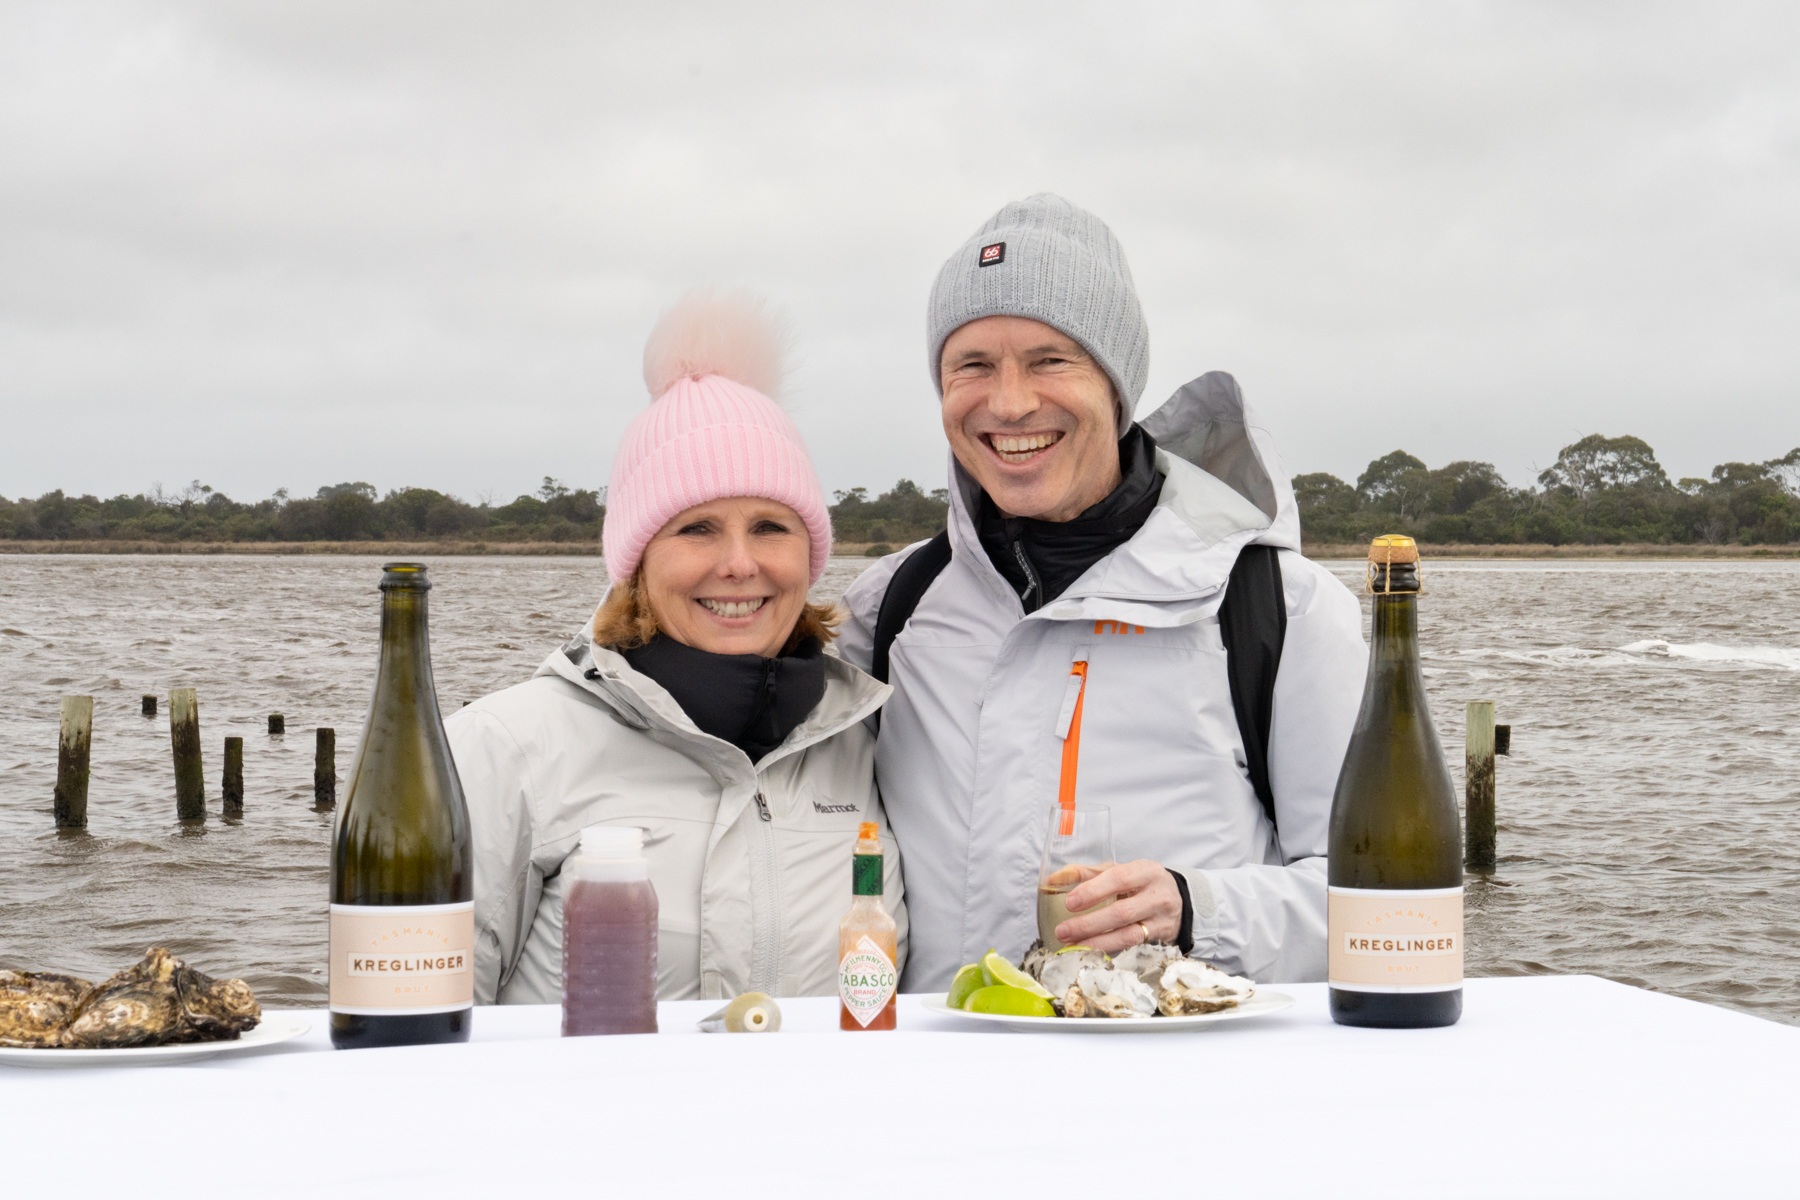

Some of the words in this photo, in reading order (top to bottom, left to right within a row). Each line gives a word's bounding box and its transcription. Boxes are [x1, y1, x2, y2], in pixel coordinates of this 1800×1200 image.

[812, 800, 860, 813] Marmot
[1366, 910, 1438, 927] TASMANIA
[371, 927, 449, 947] TASMANIA
[1349, 938, 1453, 951] KREGLINGER
[353, 955, 463, 972] KREGLINGER
[840, 973, 894, 987] TABASCO
[394, 985, 430, 994] BRUT
[844, 986, 866, 1008] PEPPER
[866, 987, 887, 1008] SAUCE
